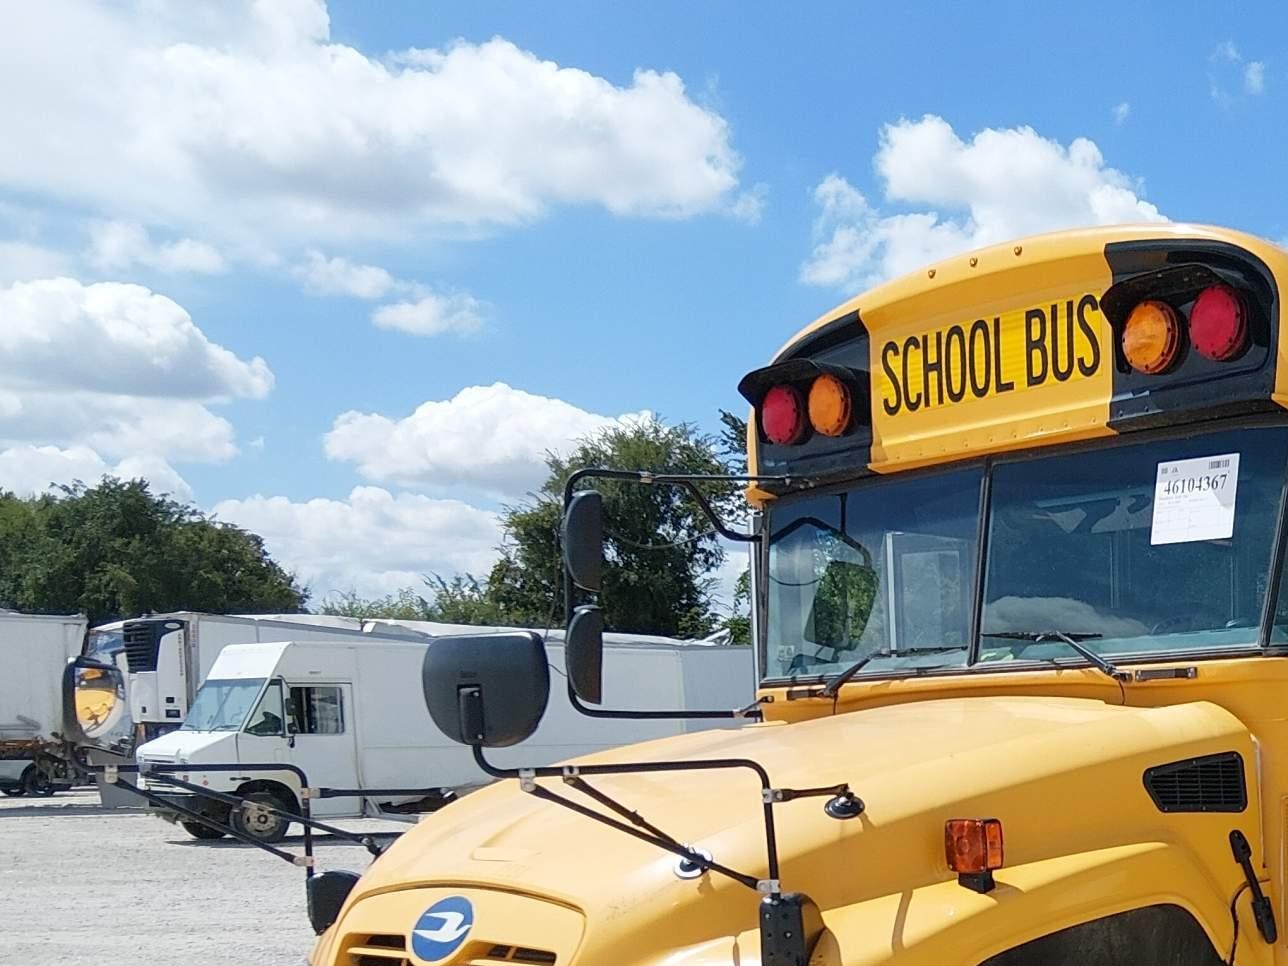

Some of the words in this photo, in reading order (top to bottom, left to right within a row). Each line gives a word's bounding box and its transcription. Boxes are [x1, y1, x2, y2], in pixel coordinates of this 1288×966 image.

[881, 317, 1014, 416] SCHOOL
[1025, 294, 1101, 388] BUS
[1163, 473, 1227, 496] 46104367
